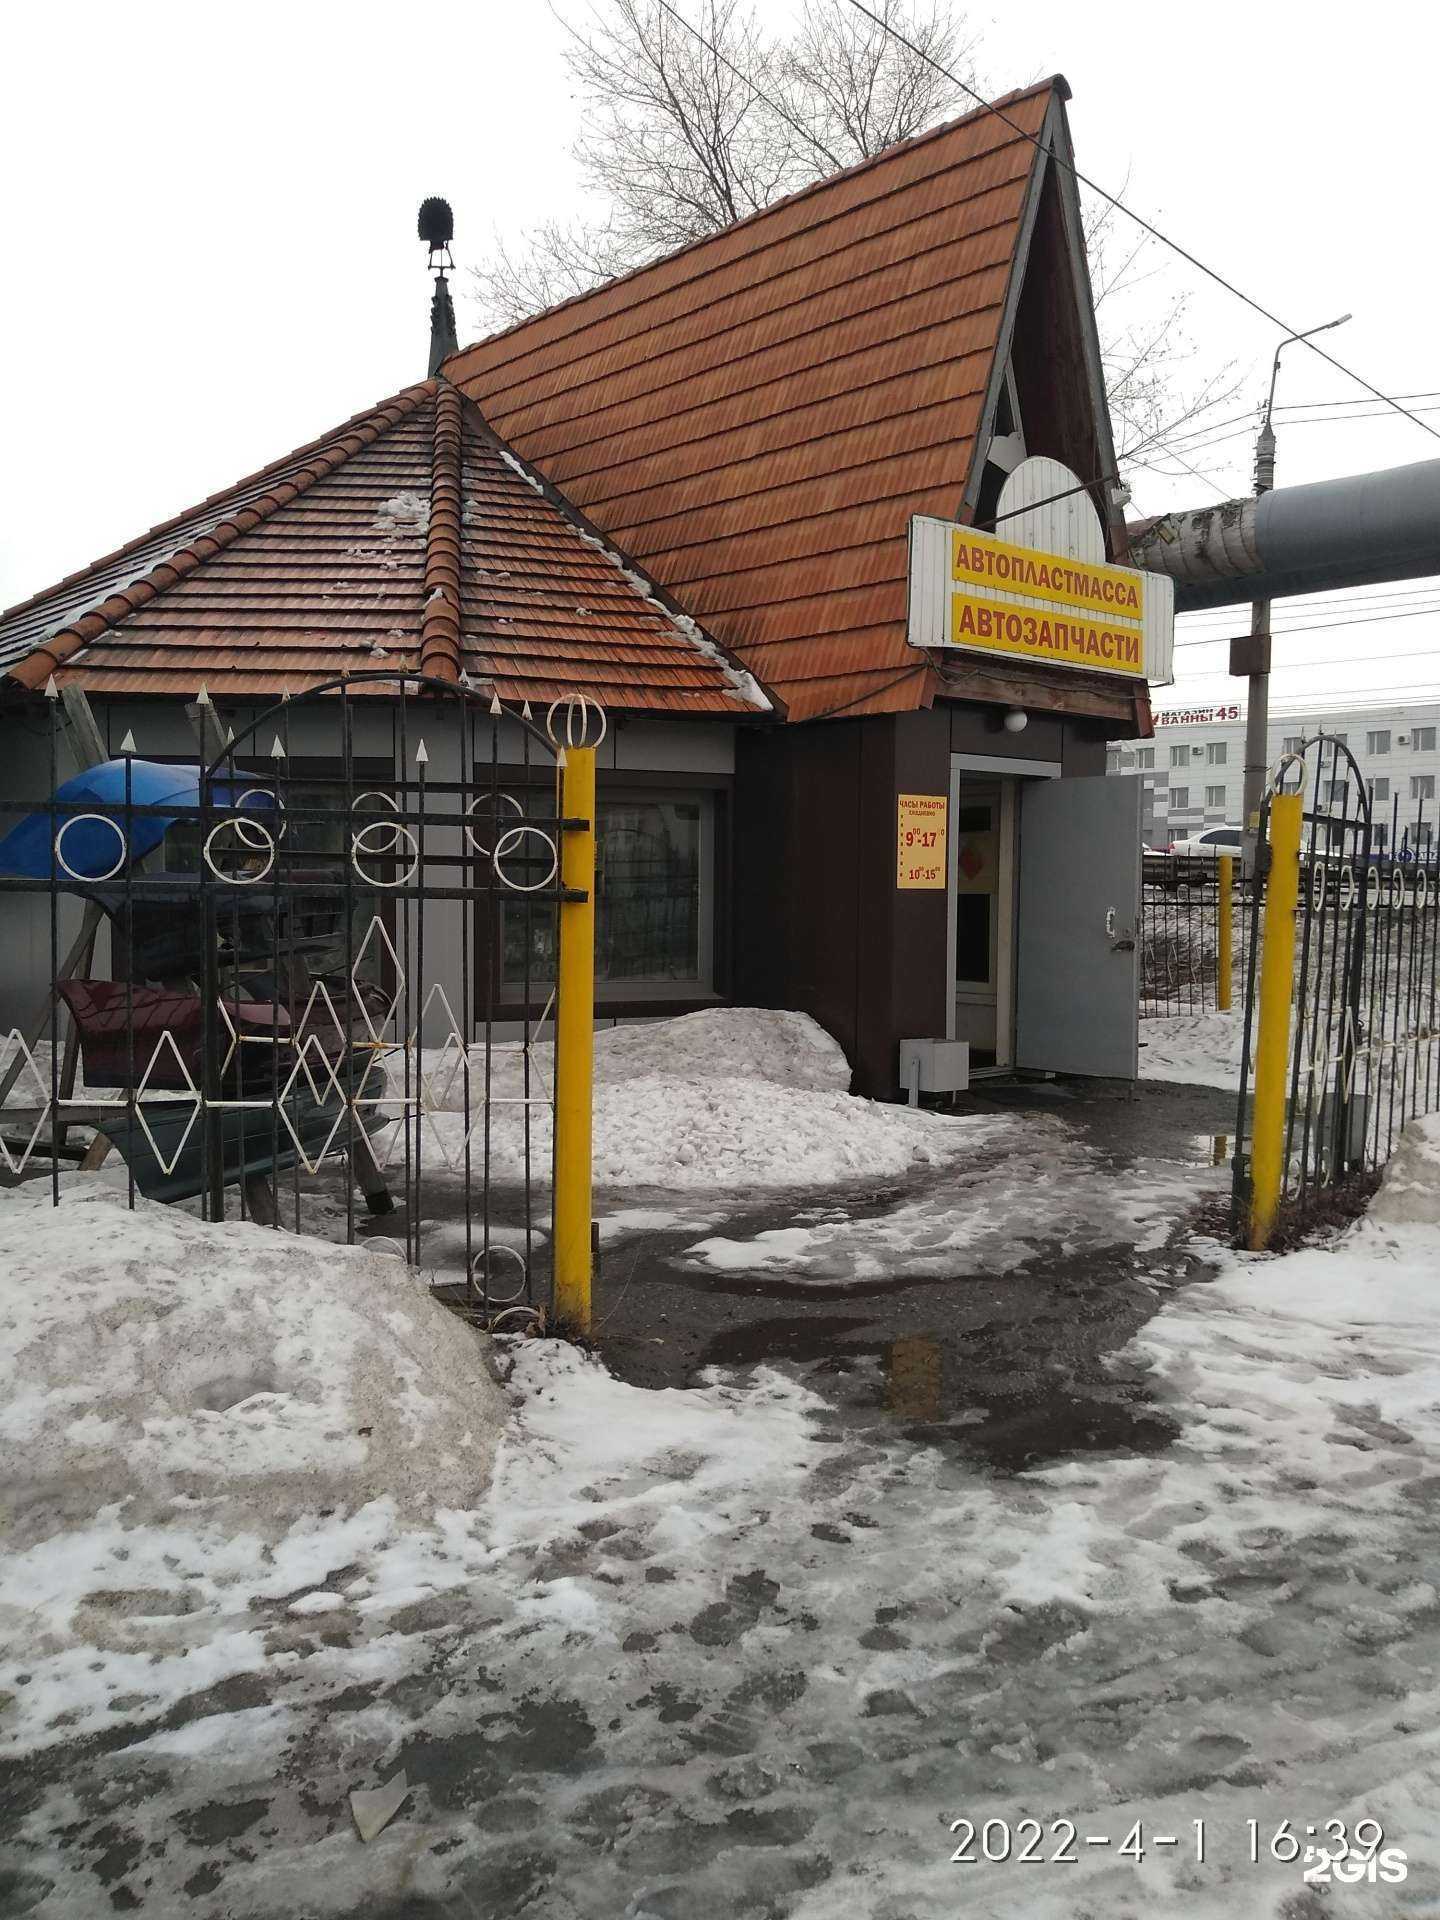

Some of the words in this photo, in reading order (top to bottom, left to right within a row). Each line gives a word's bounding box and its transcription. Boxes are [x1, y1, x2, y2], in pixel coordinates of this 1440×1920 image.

[956, 543, 1139, 609] АВТОПЛАСТМАССА
[959, 604, 1139, 664] АВТОЗАПЧАСТИ
[1161, 713, 1213, 725] ВАННЫ
[1215, 706, 1239, 720] 45
[900, 800, 918, 809] ЧАСЫ
[920, 801, 945, 810] РАБОТЫ
